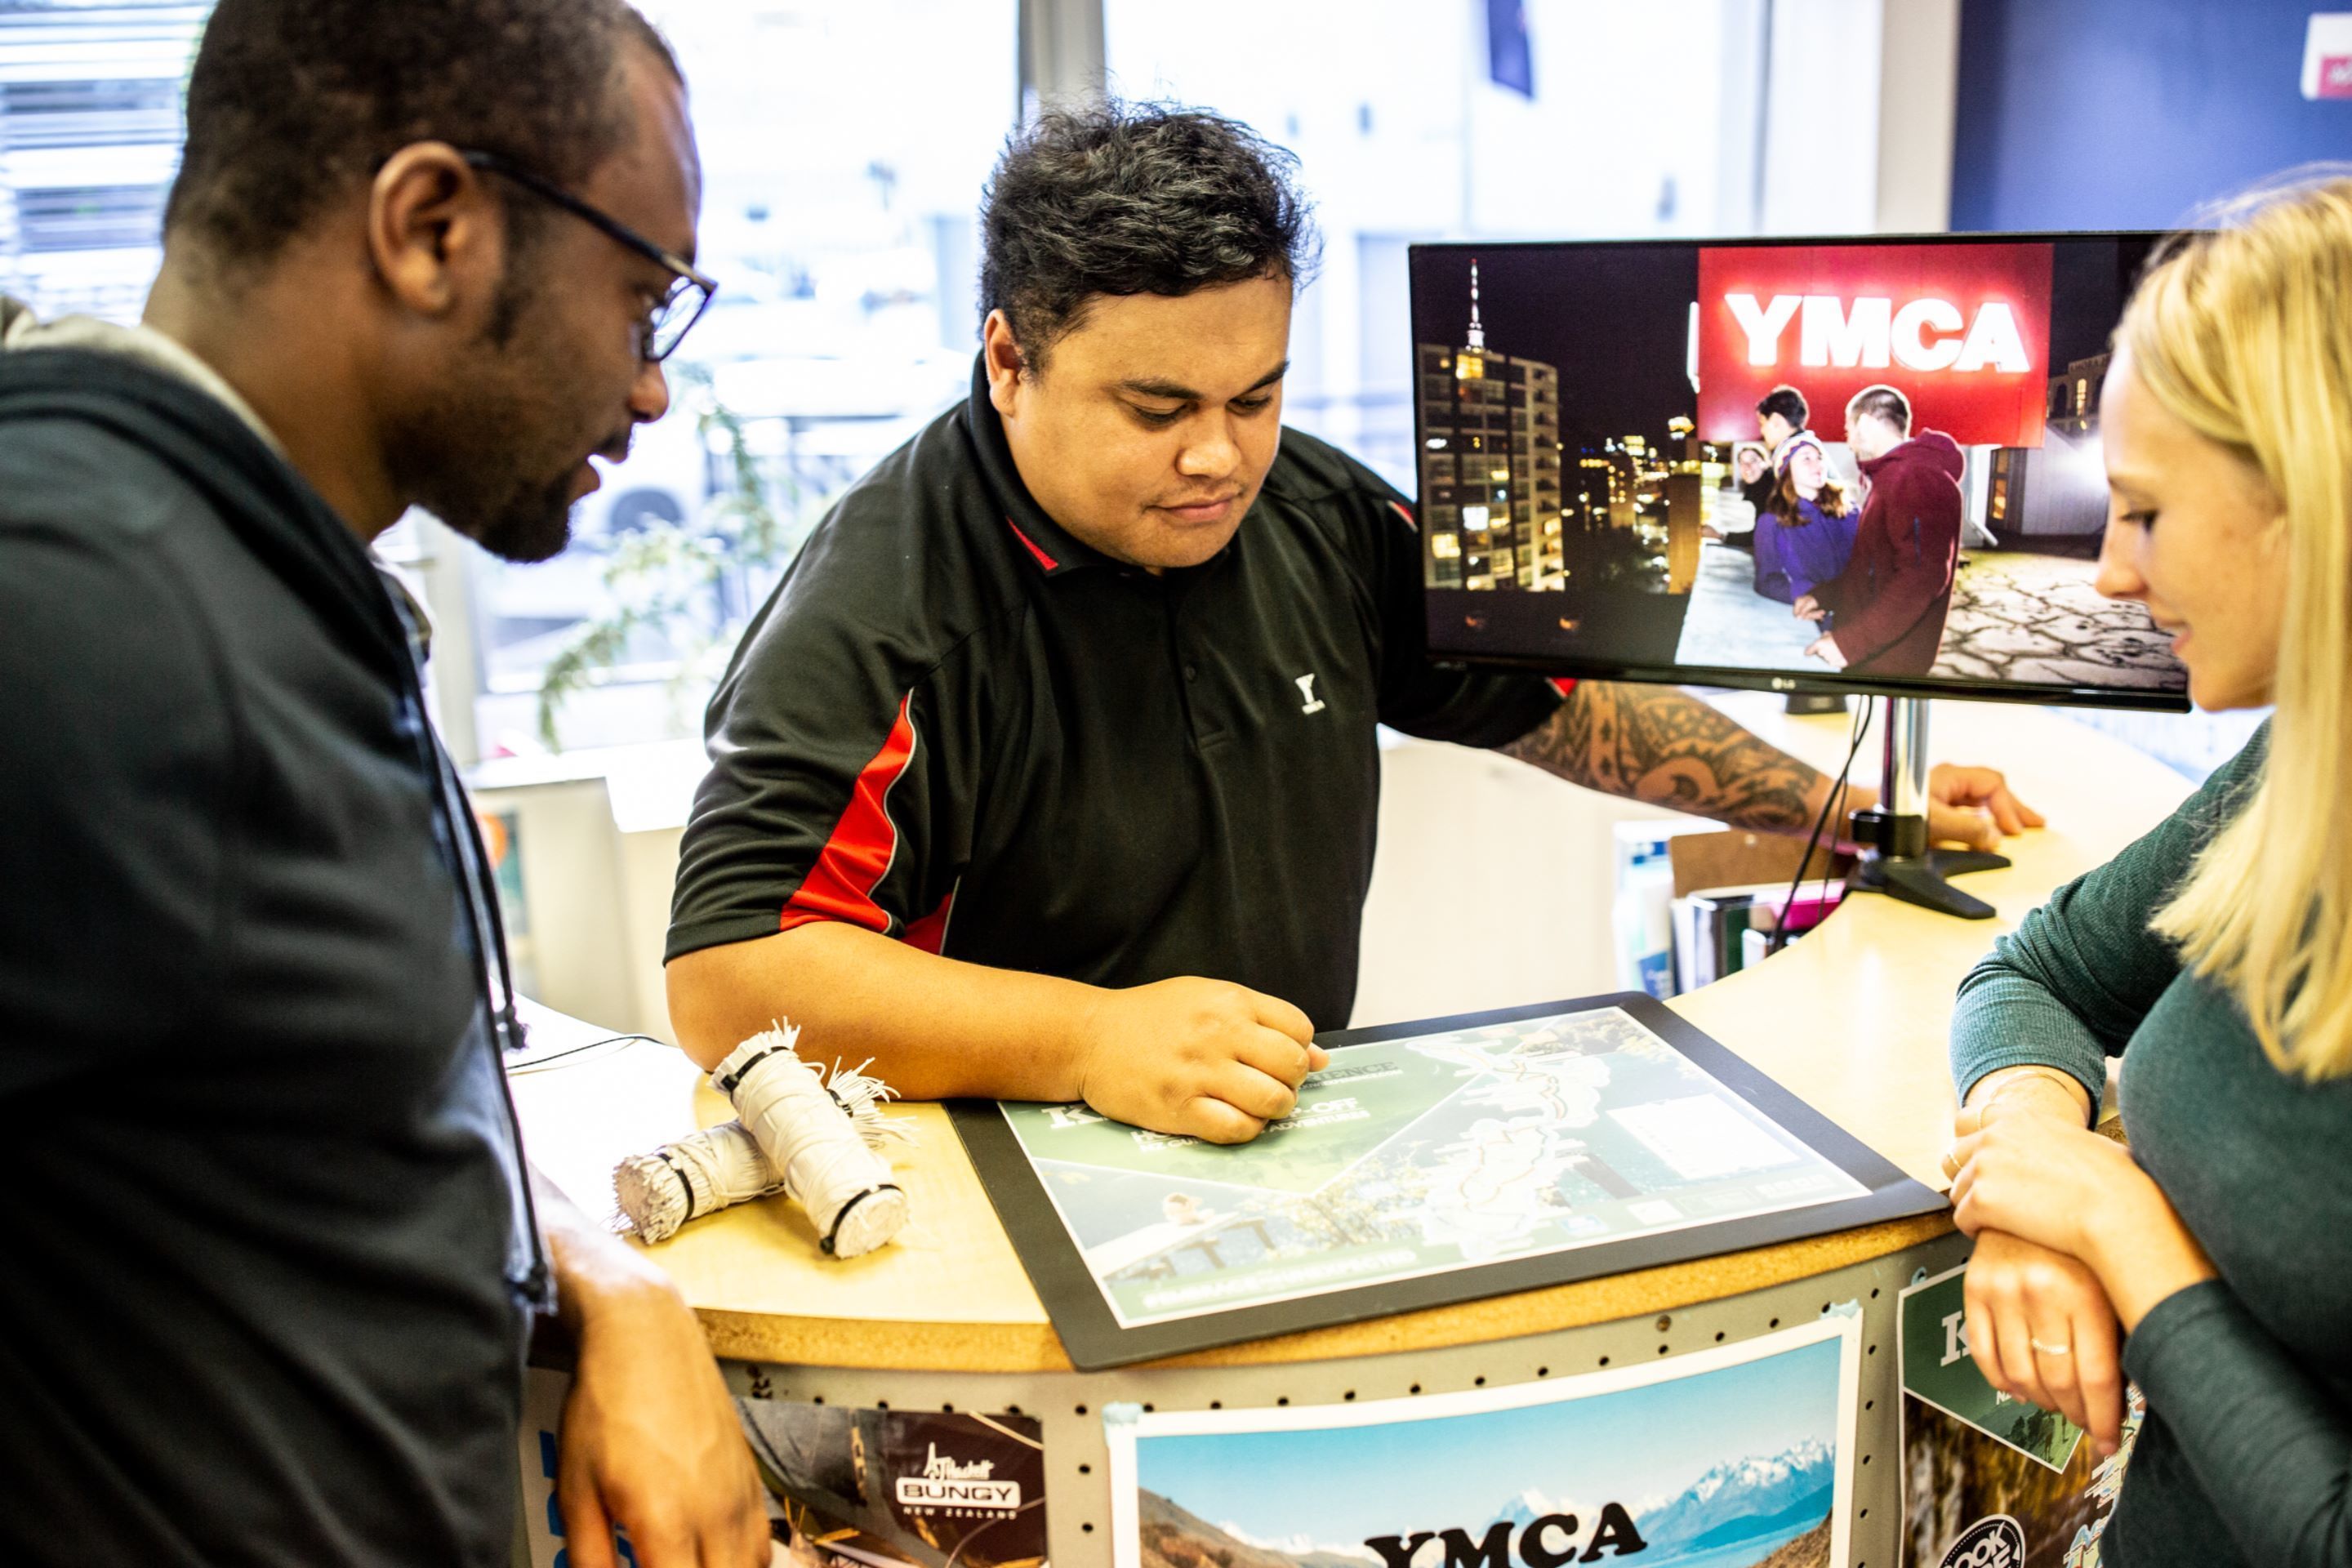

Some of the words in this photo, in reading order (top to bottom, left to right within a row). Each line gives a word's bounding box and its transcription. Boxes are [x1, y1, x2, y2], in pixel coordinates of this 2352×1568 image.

[1723, 293, 2032, 374] YMCA
[903, 1484, 1012, 1501] BUNGY
[903, 1507, 935, 1517] NEW
[946, 1508, 1017, 1521] ZEALAND
[1364, 1502, 1648, 1568] YMCA
[1942, 1521, 2007, 1568] OOK
